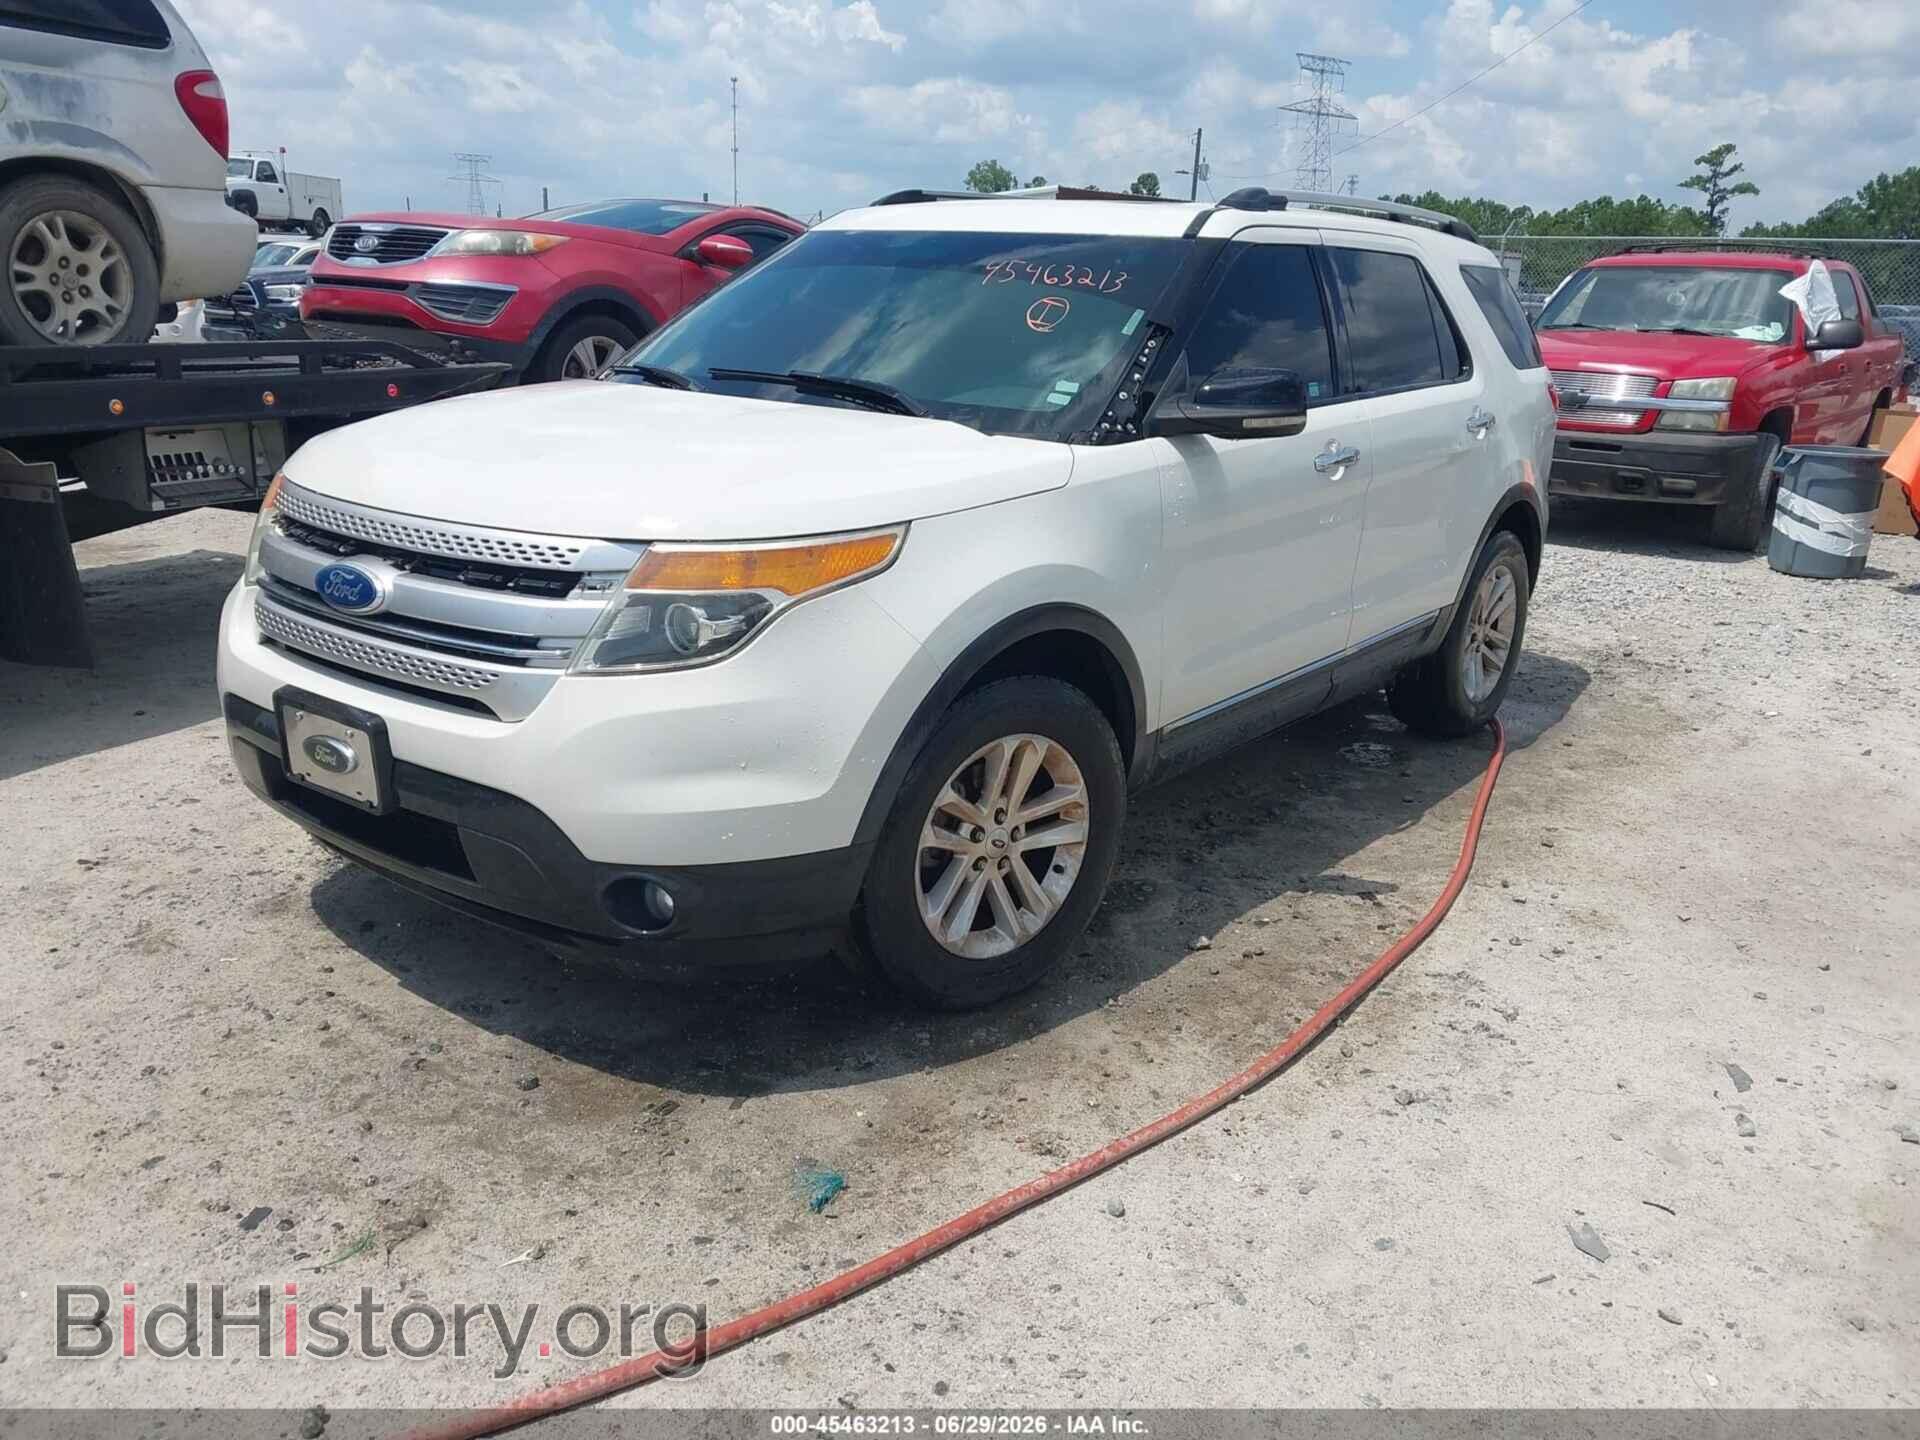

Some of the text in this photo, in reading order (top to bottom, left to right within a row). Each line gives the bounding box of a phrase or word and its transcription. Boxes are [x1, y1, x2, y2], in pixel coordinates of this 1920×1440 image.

[982, 259, 1128, 293] 45463213
[324, 570, 363, 600] Ford
[314, 744, 338, 766] Ford
